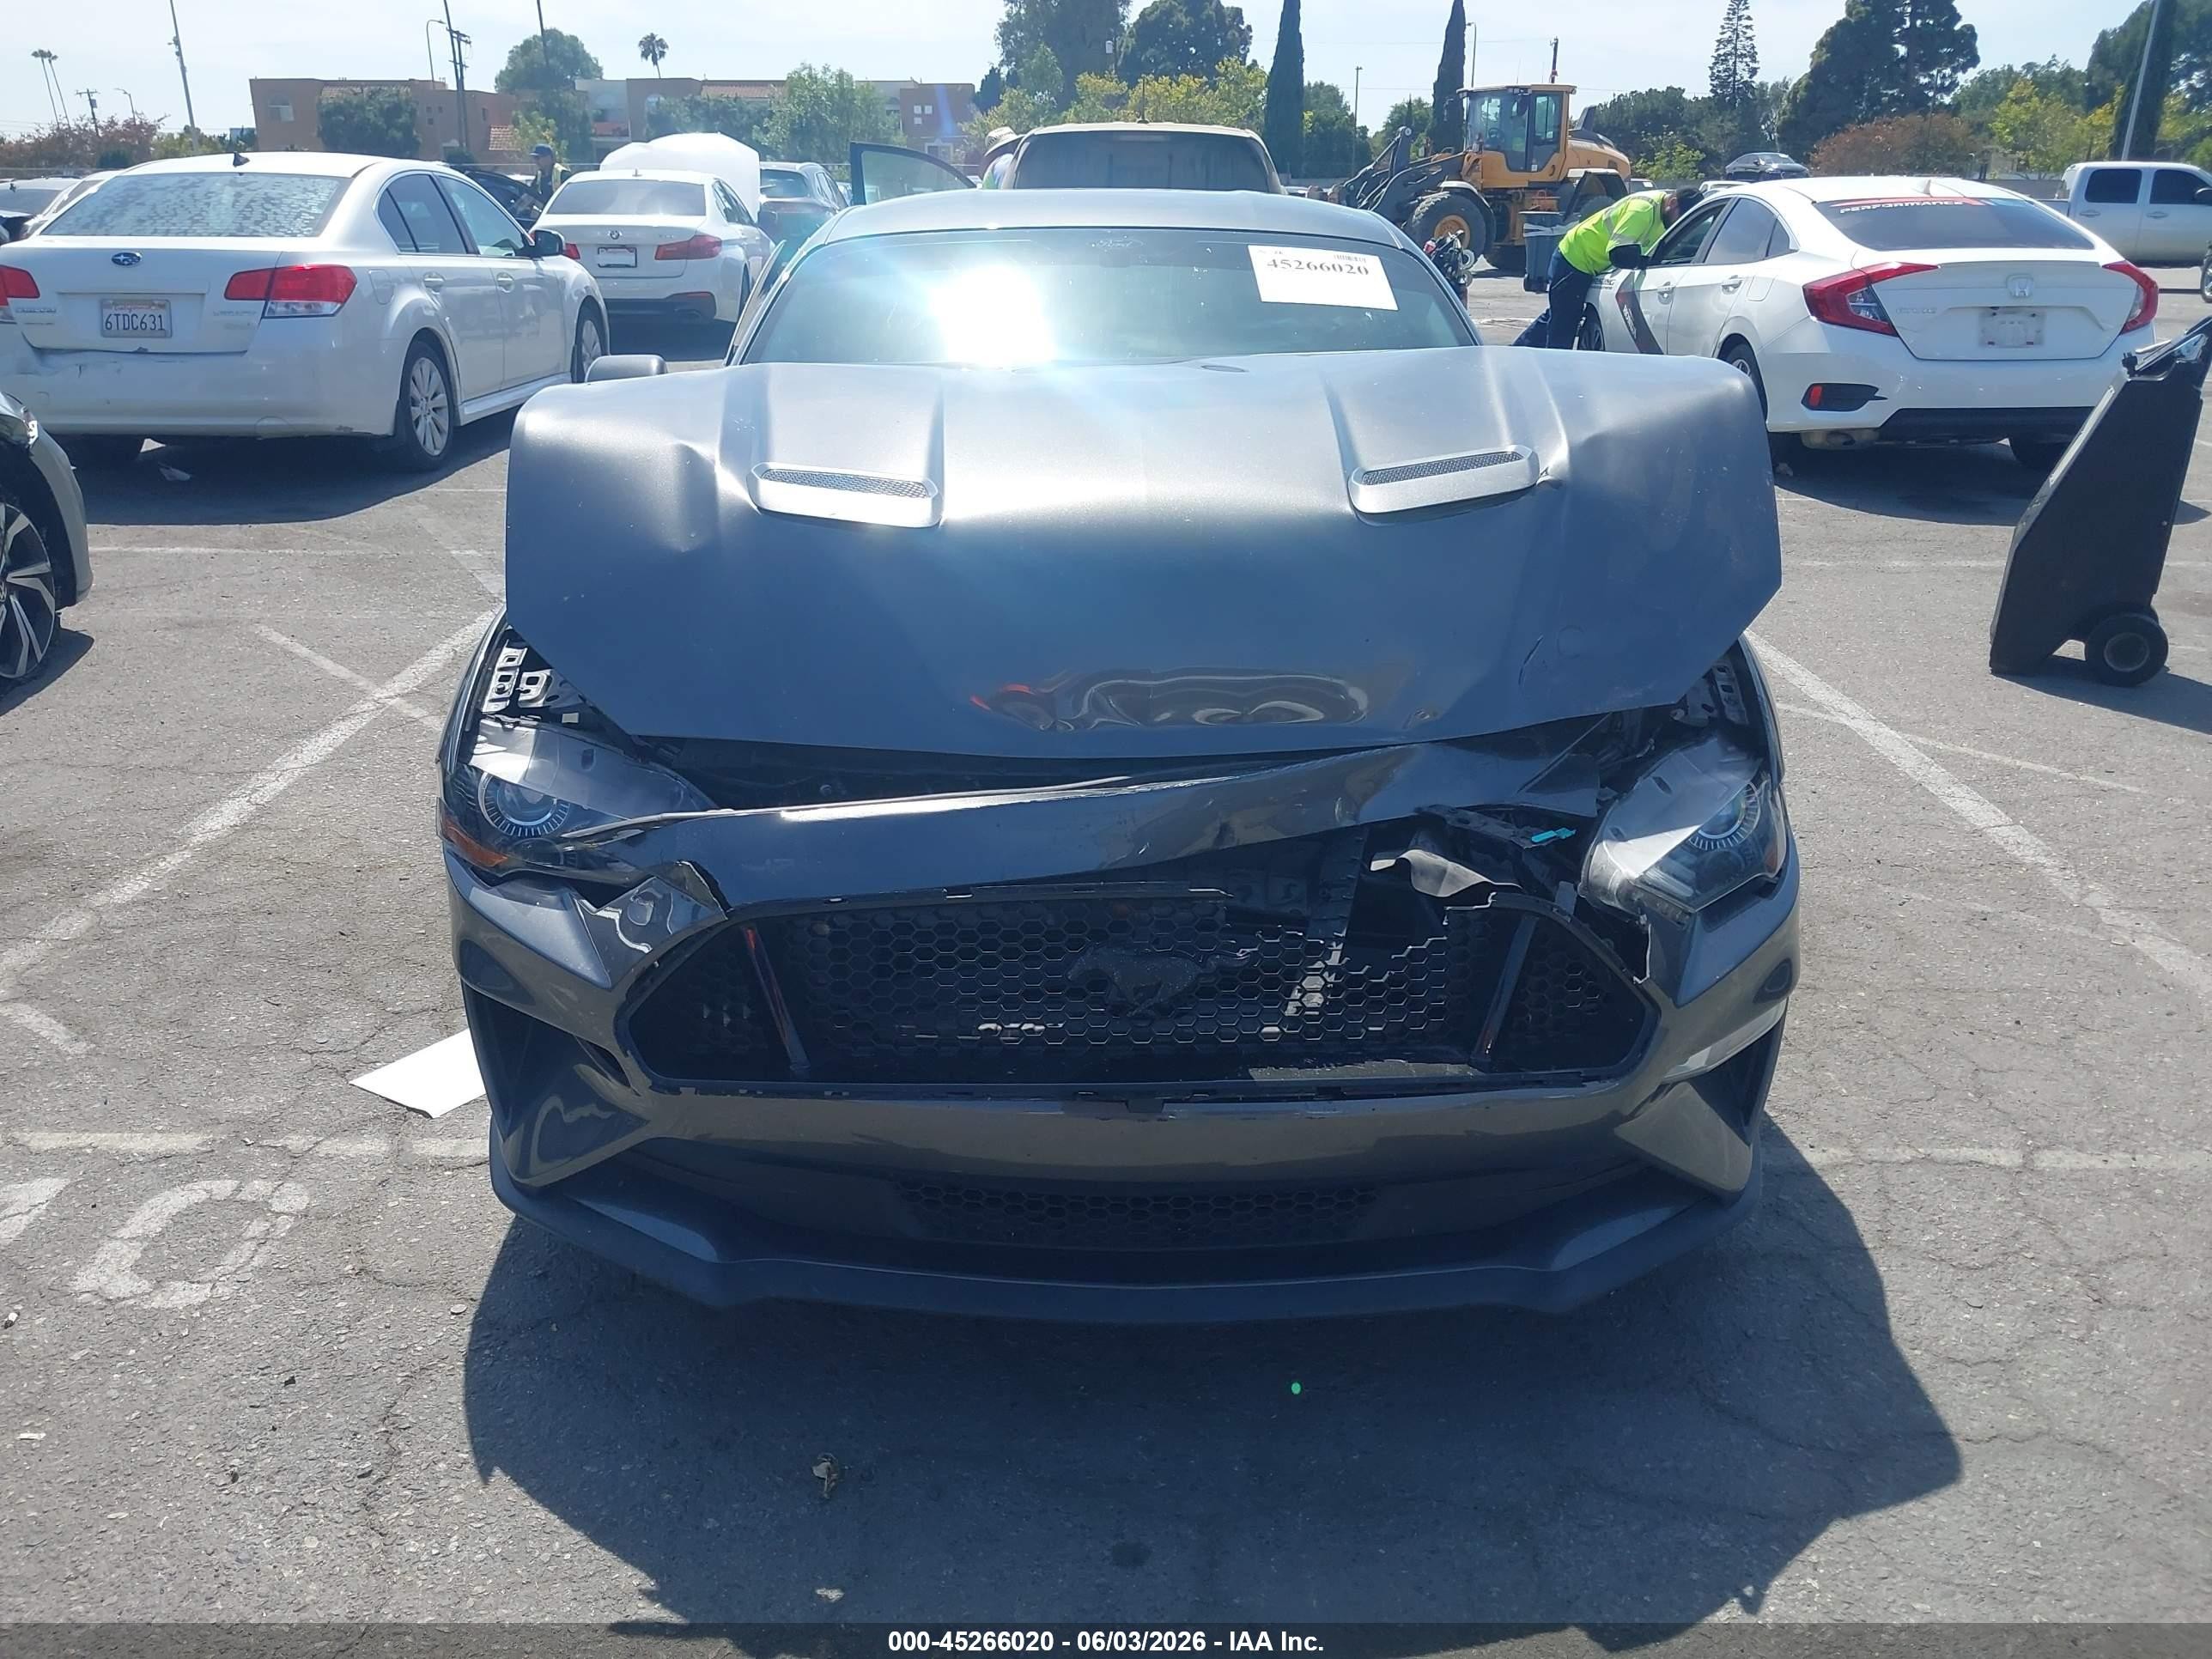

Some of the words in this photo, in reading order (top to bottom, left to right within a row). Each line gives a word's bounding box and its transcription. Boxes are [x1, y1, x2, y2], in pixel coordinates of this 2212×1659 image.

[1839, 201, 1964, 214] PERFORMANCE
[1266, 258, 1370, 276] 45266020
[105, 313, 166, 331] 6TDC631
